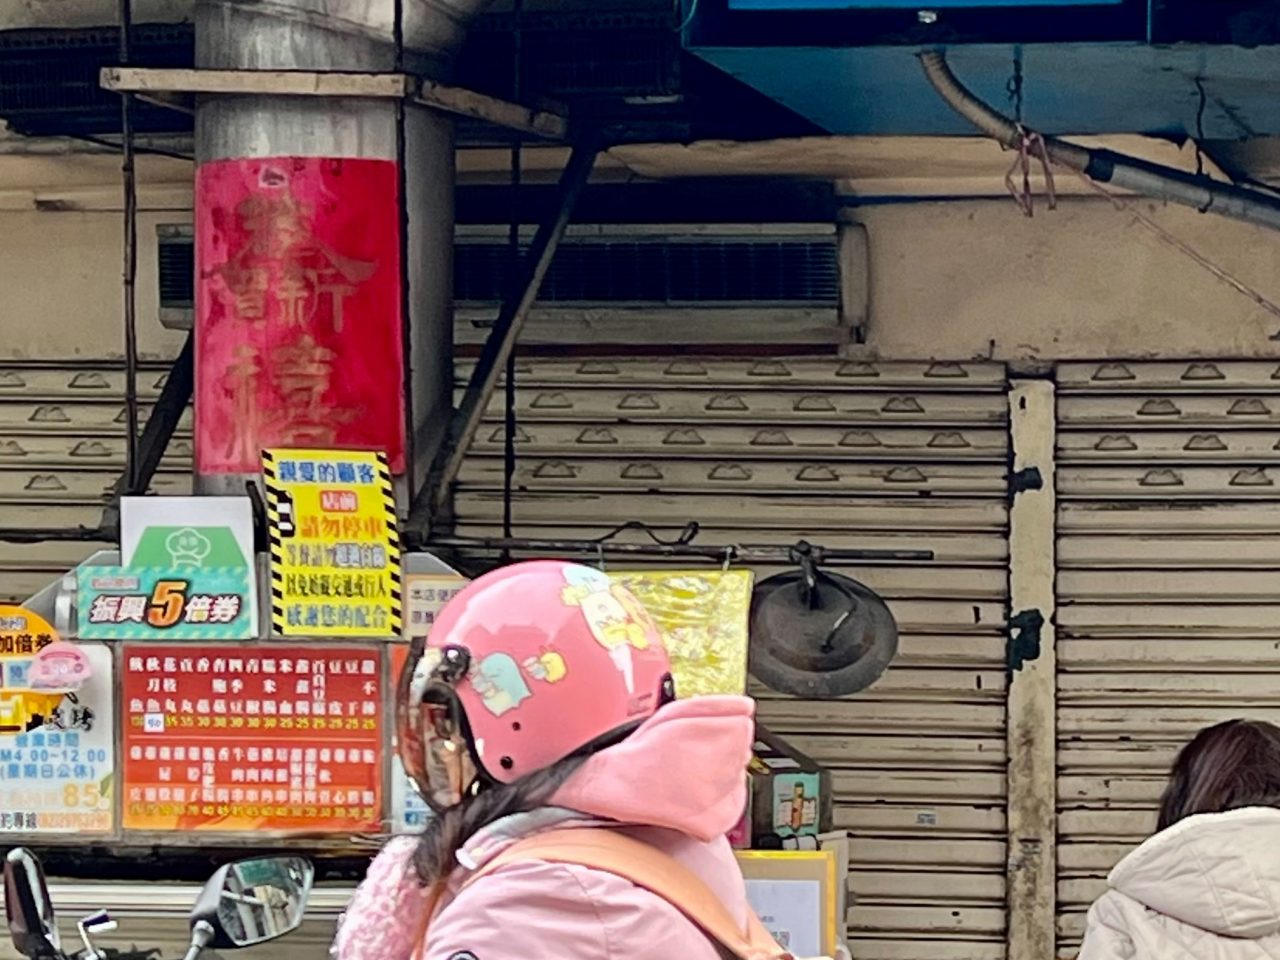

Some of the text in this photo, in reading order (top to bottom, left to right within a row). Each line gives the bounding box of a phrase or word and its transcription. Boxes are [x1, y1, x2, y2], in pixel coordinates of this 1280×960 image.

[278, 461, 375, 483] 親愛的顧客
[301, 516, 382, 539] 請勿停車
[91, 580, 240, 627] 振興5倍券
